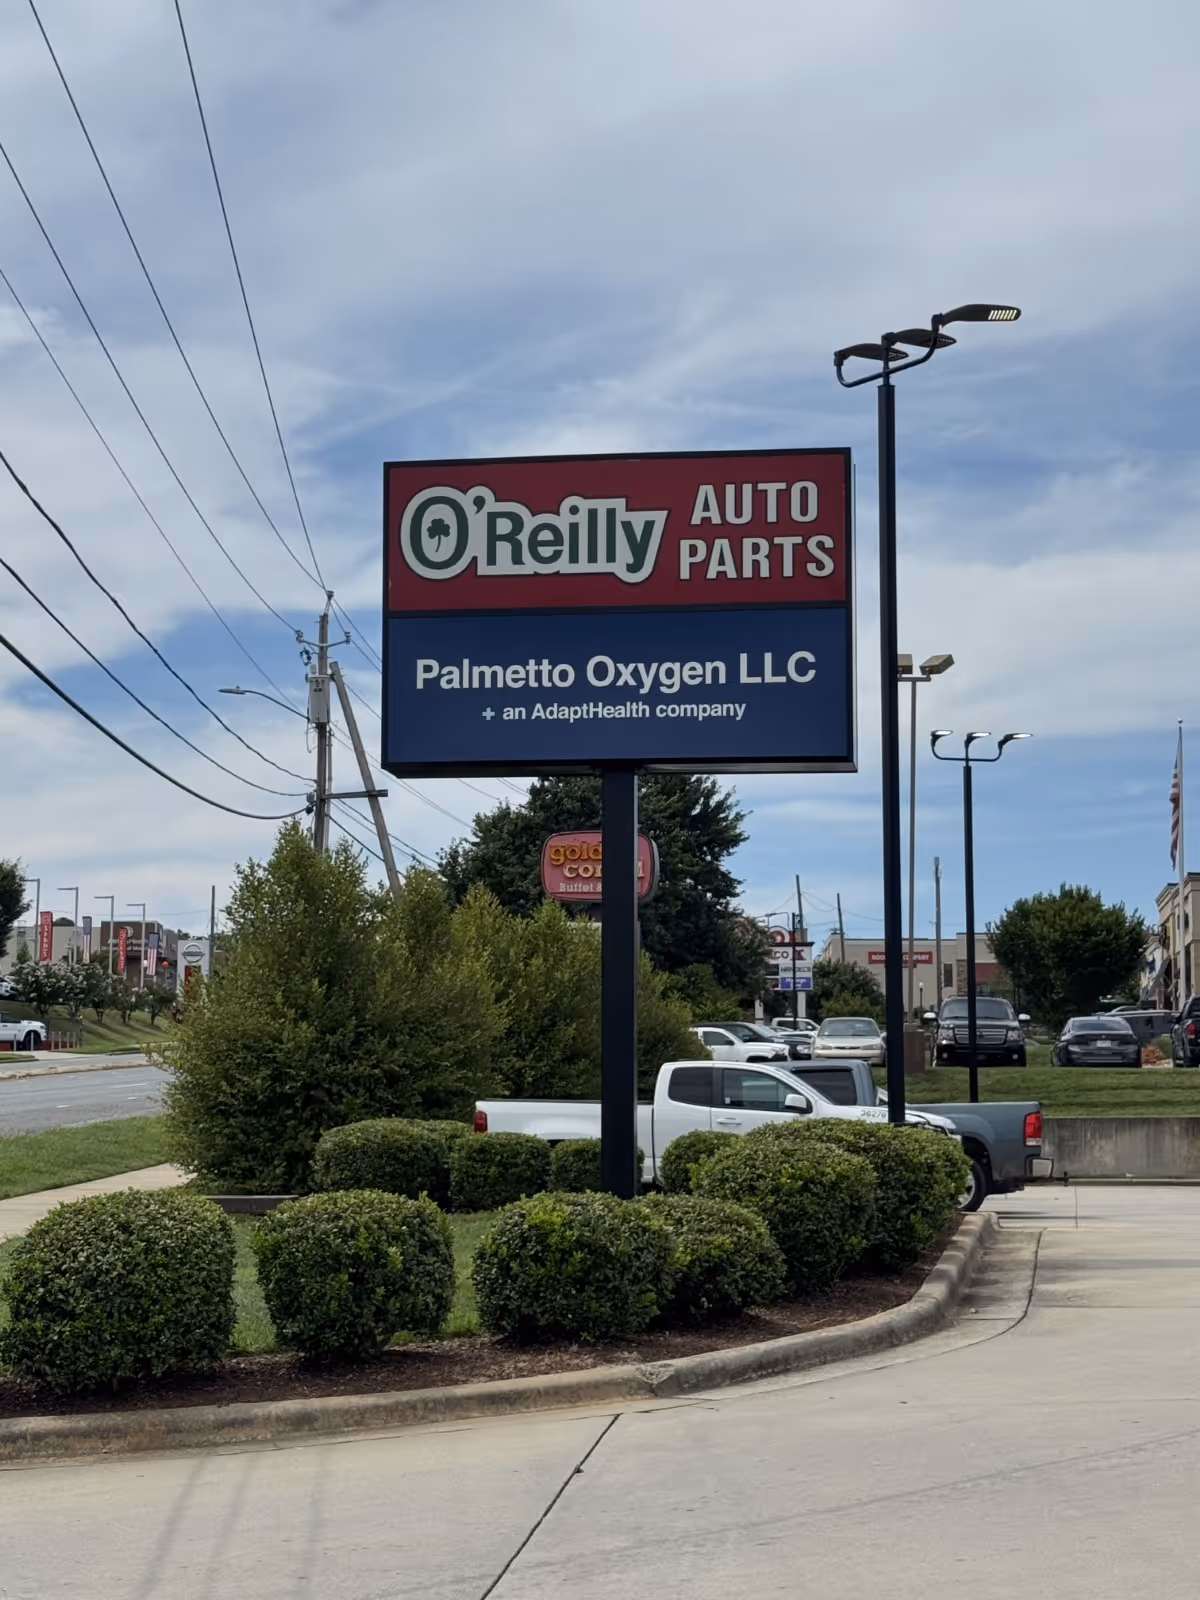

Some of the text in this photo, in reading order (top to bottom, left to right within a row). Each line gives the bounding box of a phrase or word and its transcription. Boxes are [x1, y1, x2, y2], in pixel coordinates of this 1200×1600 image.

[690, 480, 819, 525] AUTO
[404, 487, 664, 579] O'Reilly
[679, 534, 835, 580] PARTS
[415, 651, 817, 694] Palmetto Oxygen LLC
[502, 706, 526, 720] an
[531, 701, 650, 723] AdaptHealth
[655, 702, 746, 721] company
[549, 841, 602, 865] gold
[560, 882, 594, 892] Buffet
